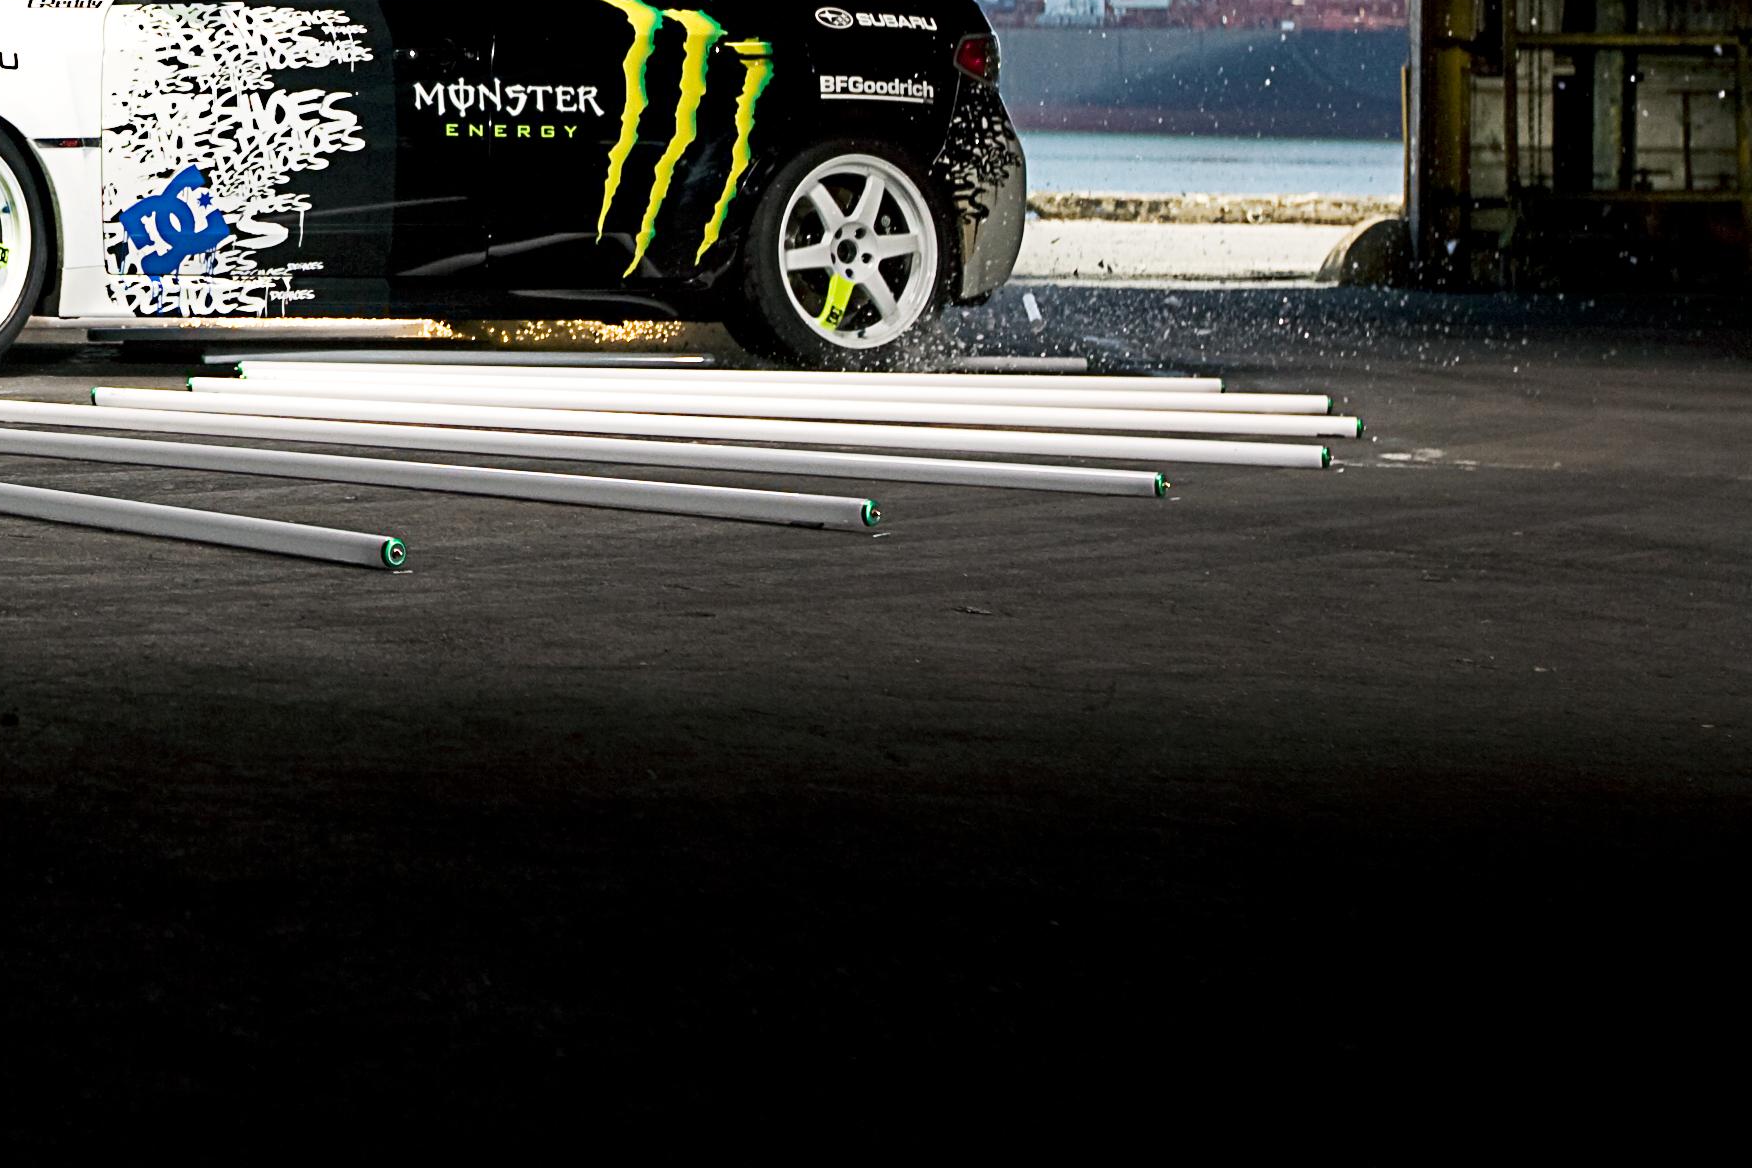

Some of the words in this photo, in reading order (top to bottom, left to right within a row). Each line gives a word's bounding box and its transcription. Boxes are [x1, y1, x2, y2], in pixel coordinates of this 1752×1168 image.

[856, 12, 938, 31] SUBARU
[819, 75, 934, 98] BFGoodrich
[445, 123, 577, 138] ENERGY
